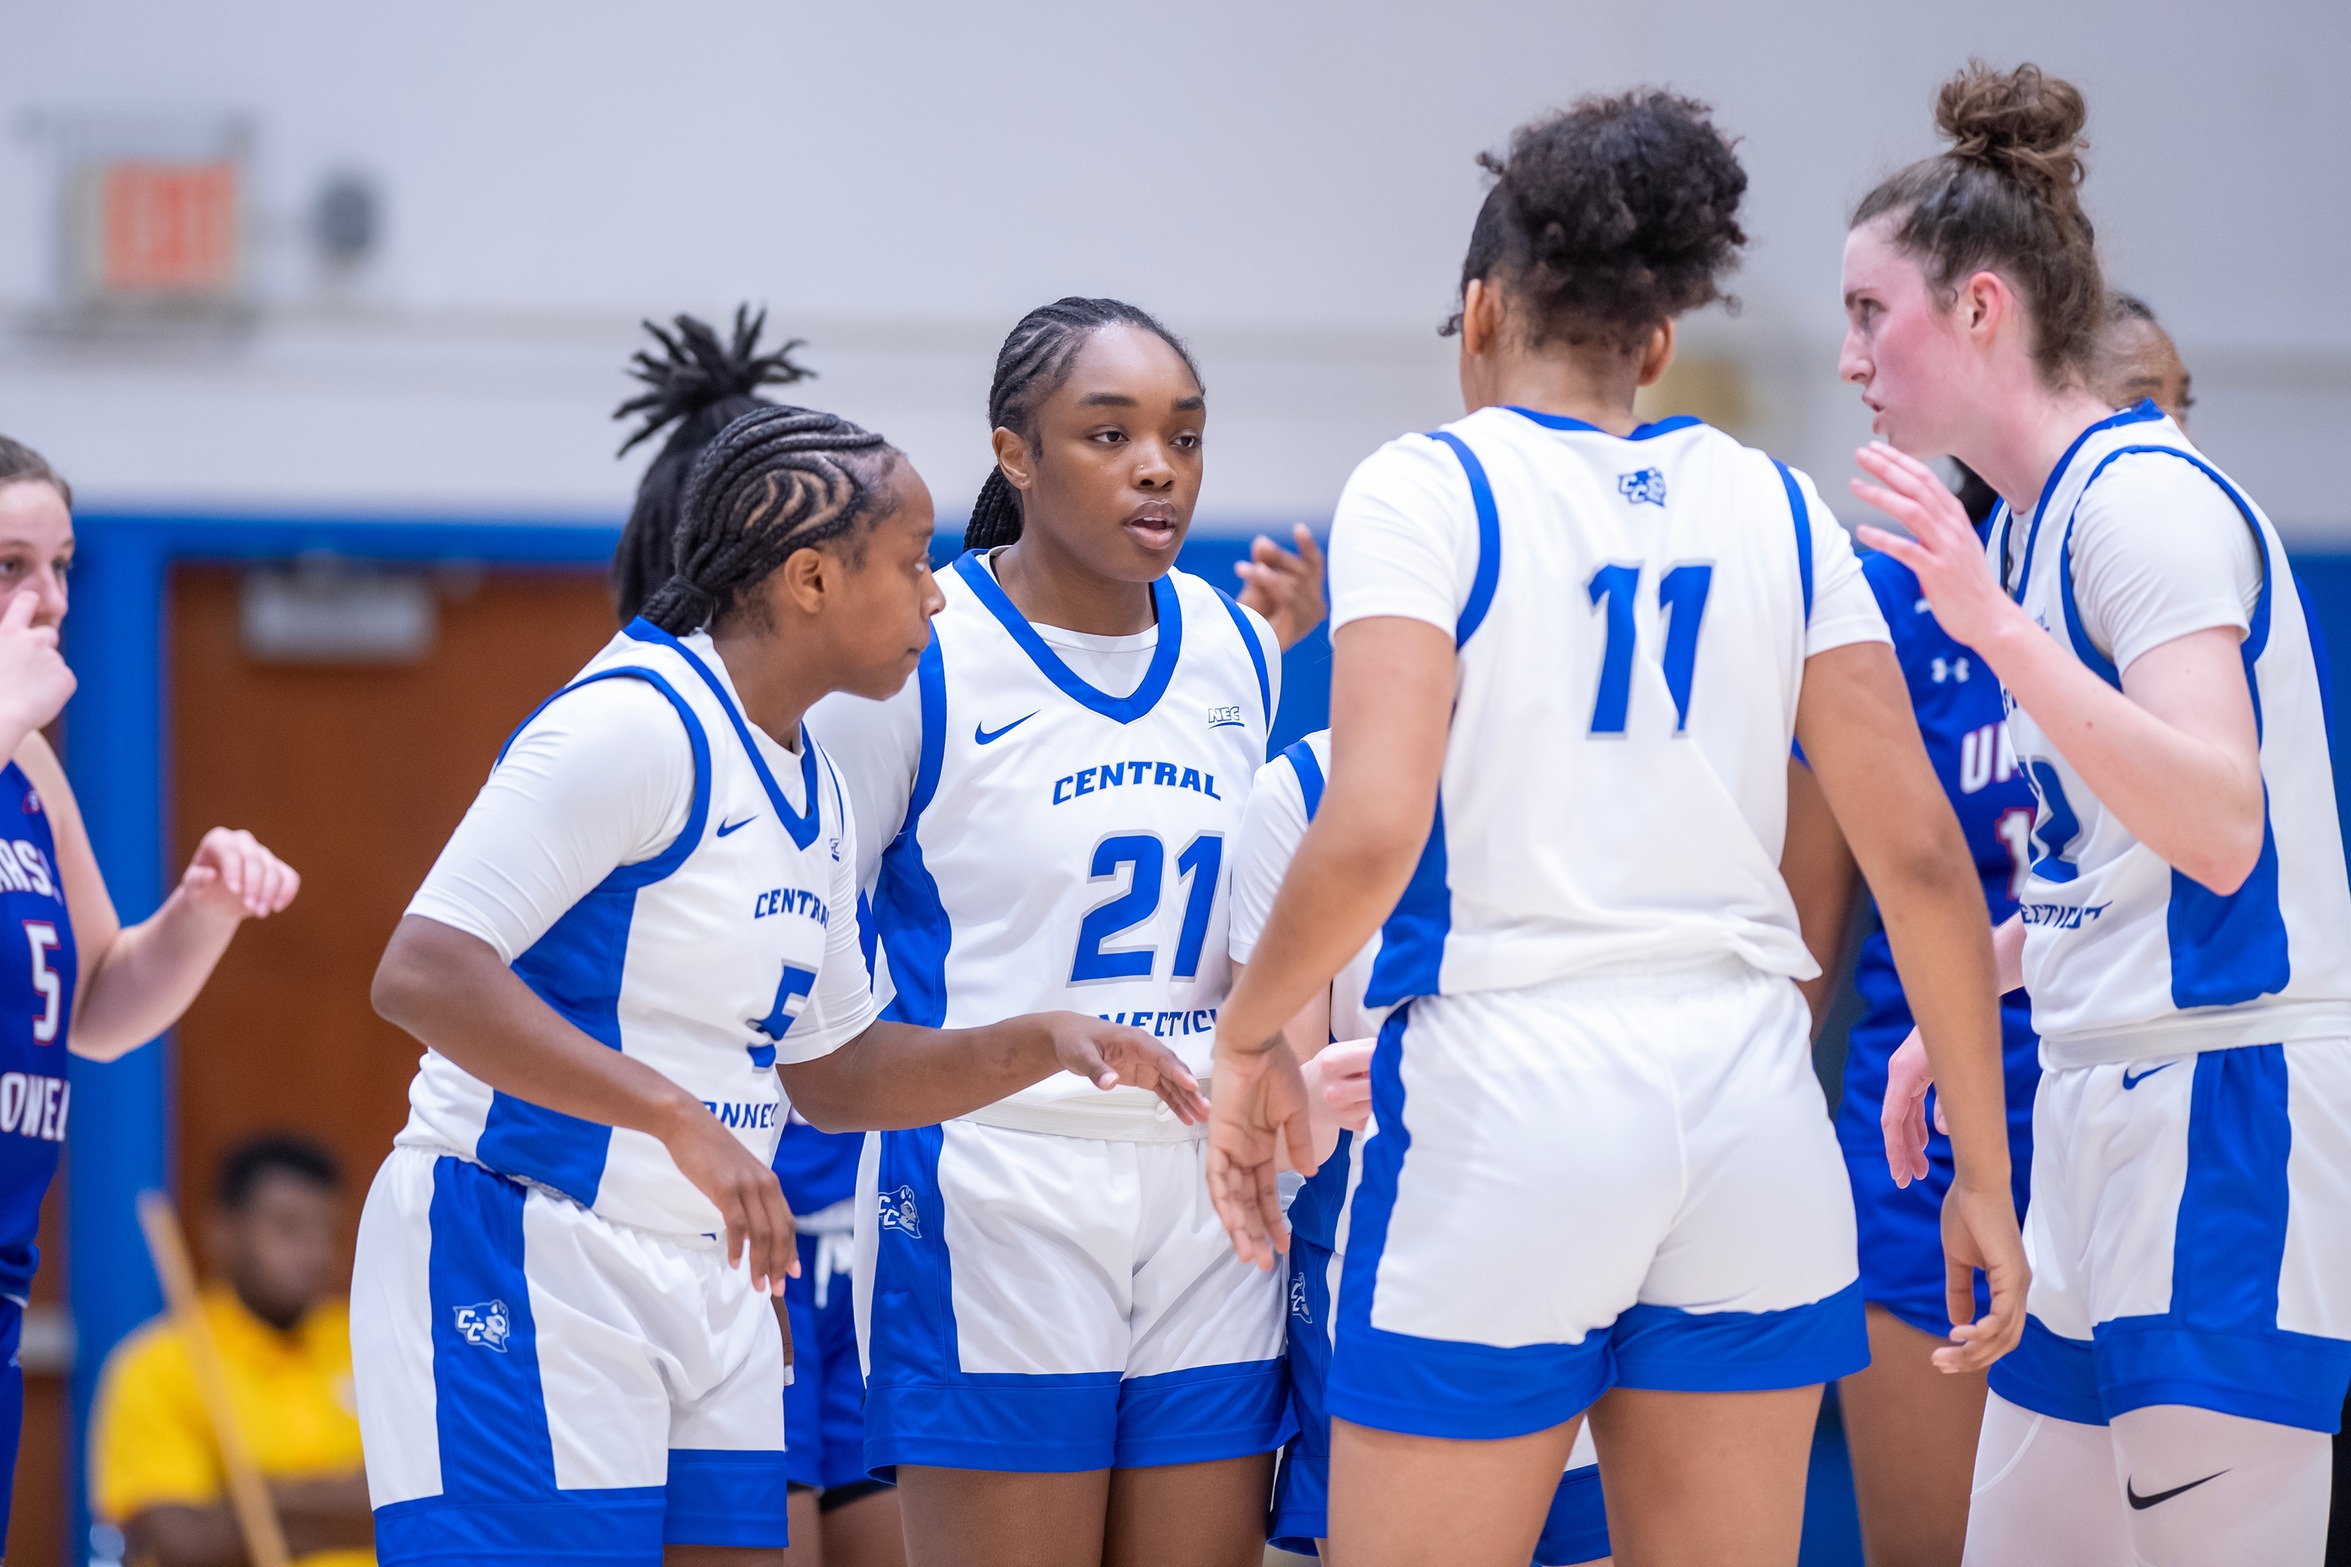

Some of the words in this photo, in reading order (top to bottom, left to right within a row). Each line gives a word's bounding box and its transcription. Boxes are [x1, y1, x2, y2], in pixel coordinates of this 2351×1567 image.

[1583, 558, 1716, 740] 11
[1207, 706, 1240, 724] NEC
[1053, 761, 1222, 805] CENTRAL
[1066, 829, 1226, 989] 21
[22, 919, 62, 1046] 5
